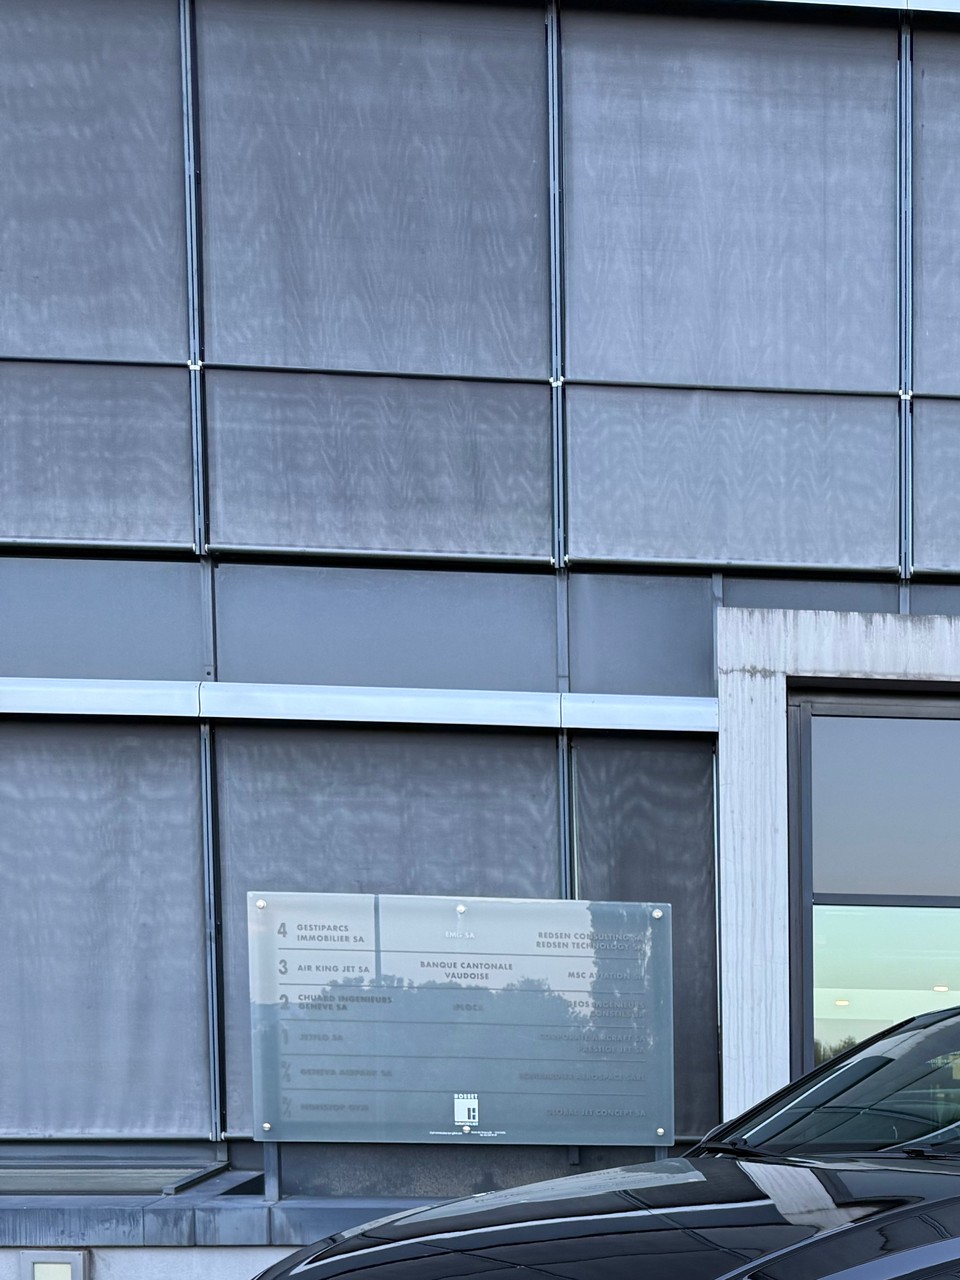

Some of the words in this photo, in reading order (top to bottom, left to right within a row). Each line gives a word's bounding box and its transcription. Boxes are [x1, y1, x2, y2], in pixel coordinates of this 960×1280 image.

[277, 922, 288, 938] 4
[296, 924, 349, 932] GESTIPARCS
[297, 934, 350, 943] IMMOBILIER
[352, 935, 365, 943] SA
[538, 932, 571, 940] REDSEN
[536, 941, 569, 949] REDSEN
[278, 959, 288, 975] 3
[297, 964, 312, 972] AIR
[315, 965, 339, 973] KING
[342, 965, 356, 973] JET
[420, 961, 458, 970] BANQUE
[460, 962, 513, 971] CANTONALE
[445, 972, 489, 980] VAUDOISE
[567, 971, 586, 979] MSC
[279, 994, 290, 1010] 2
